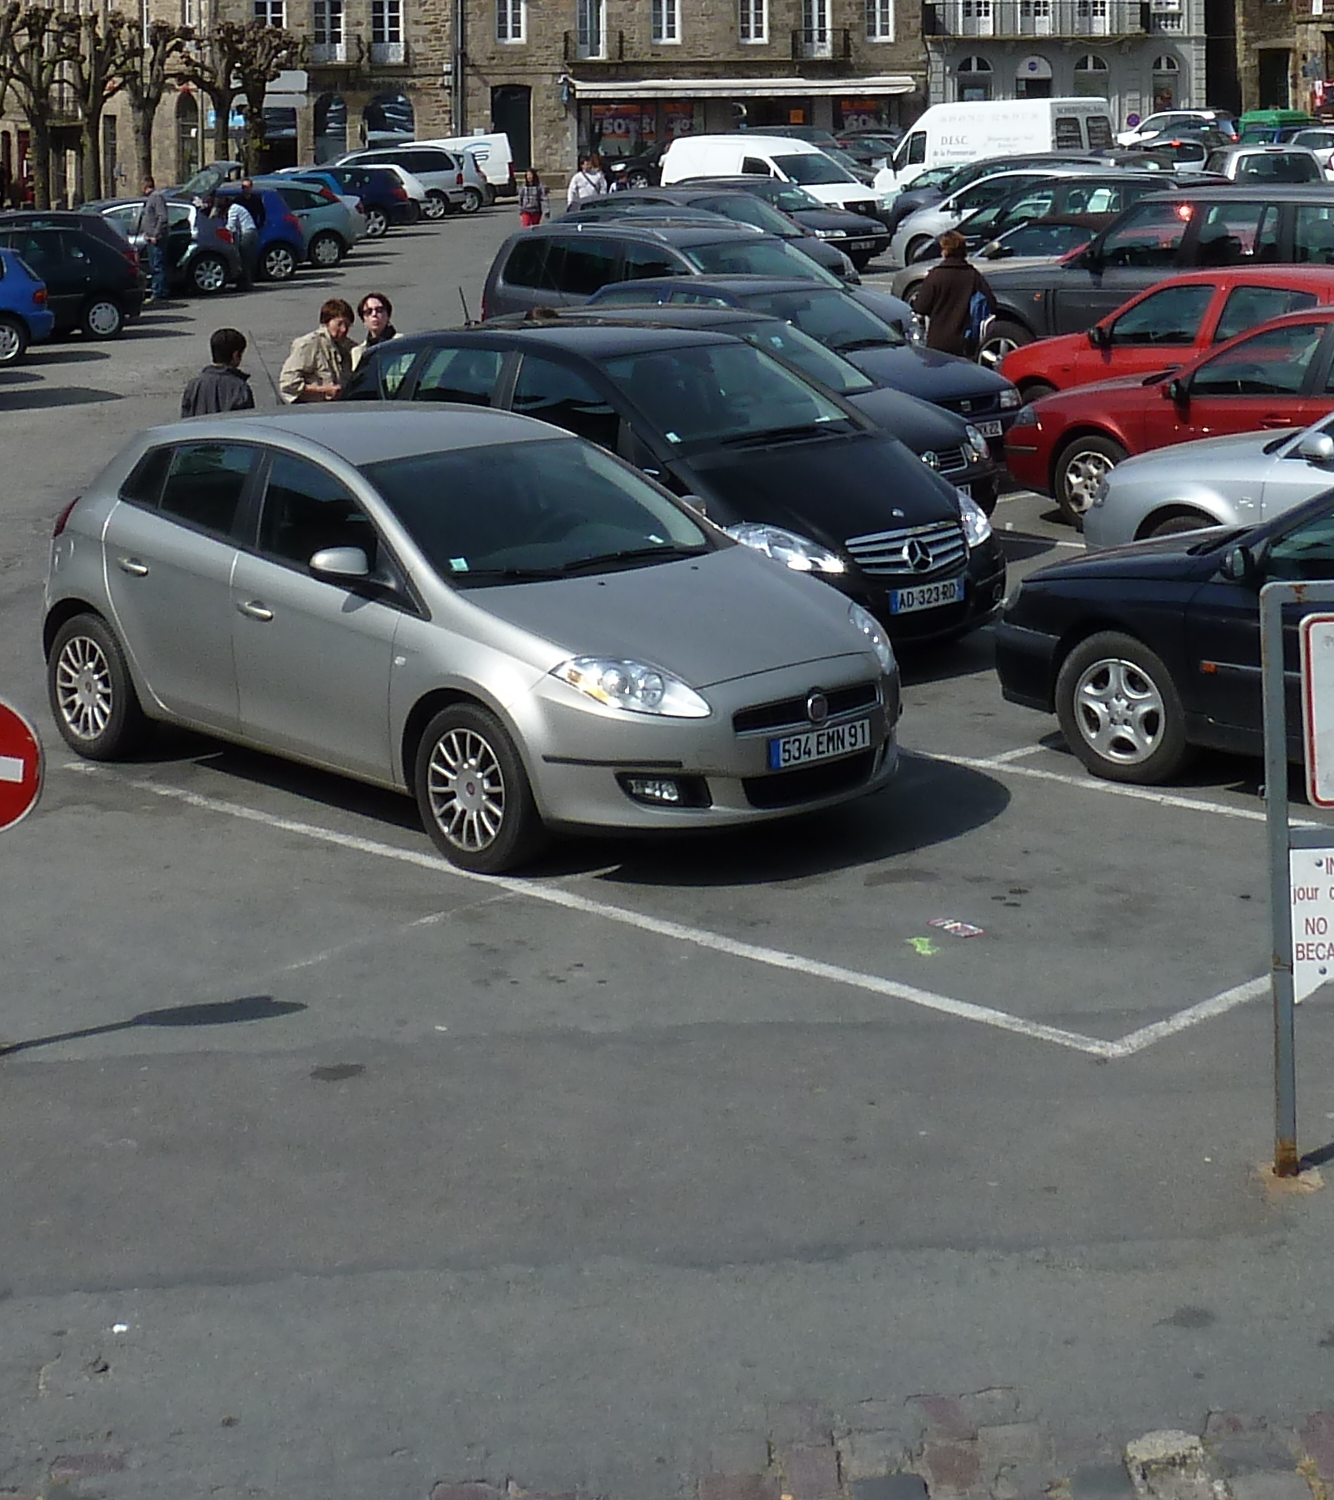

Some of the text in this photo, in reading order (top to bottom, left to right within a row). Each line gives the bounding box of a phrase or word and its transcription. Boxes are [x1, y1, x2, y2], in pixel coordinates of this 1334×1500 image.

[782, 722, 866, 763] 534 EMN 91
[1293, 884, 1320, 905] jour
[1305, 916, 1328, 936] NO
